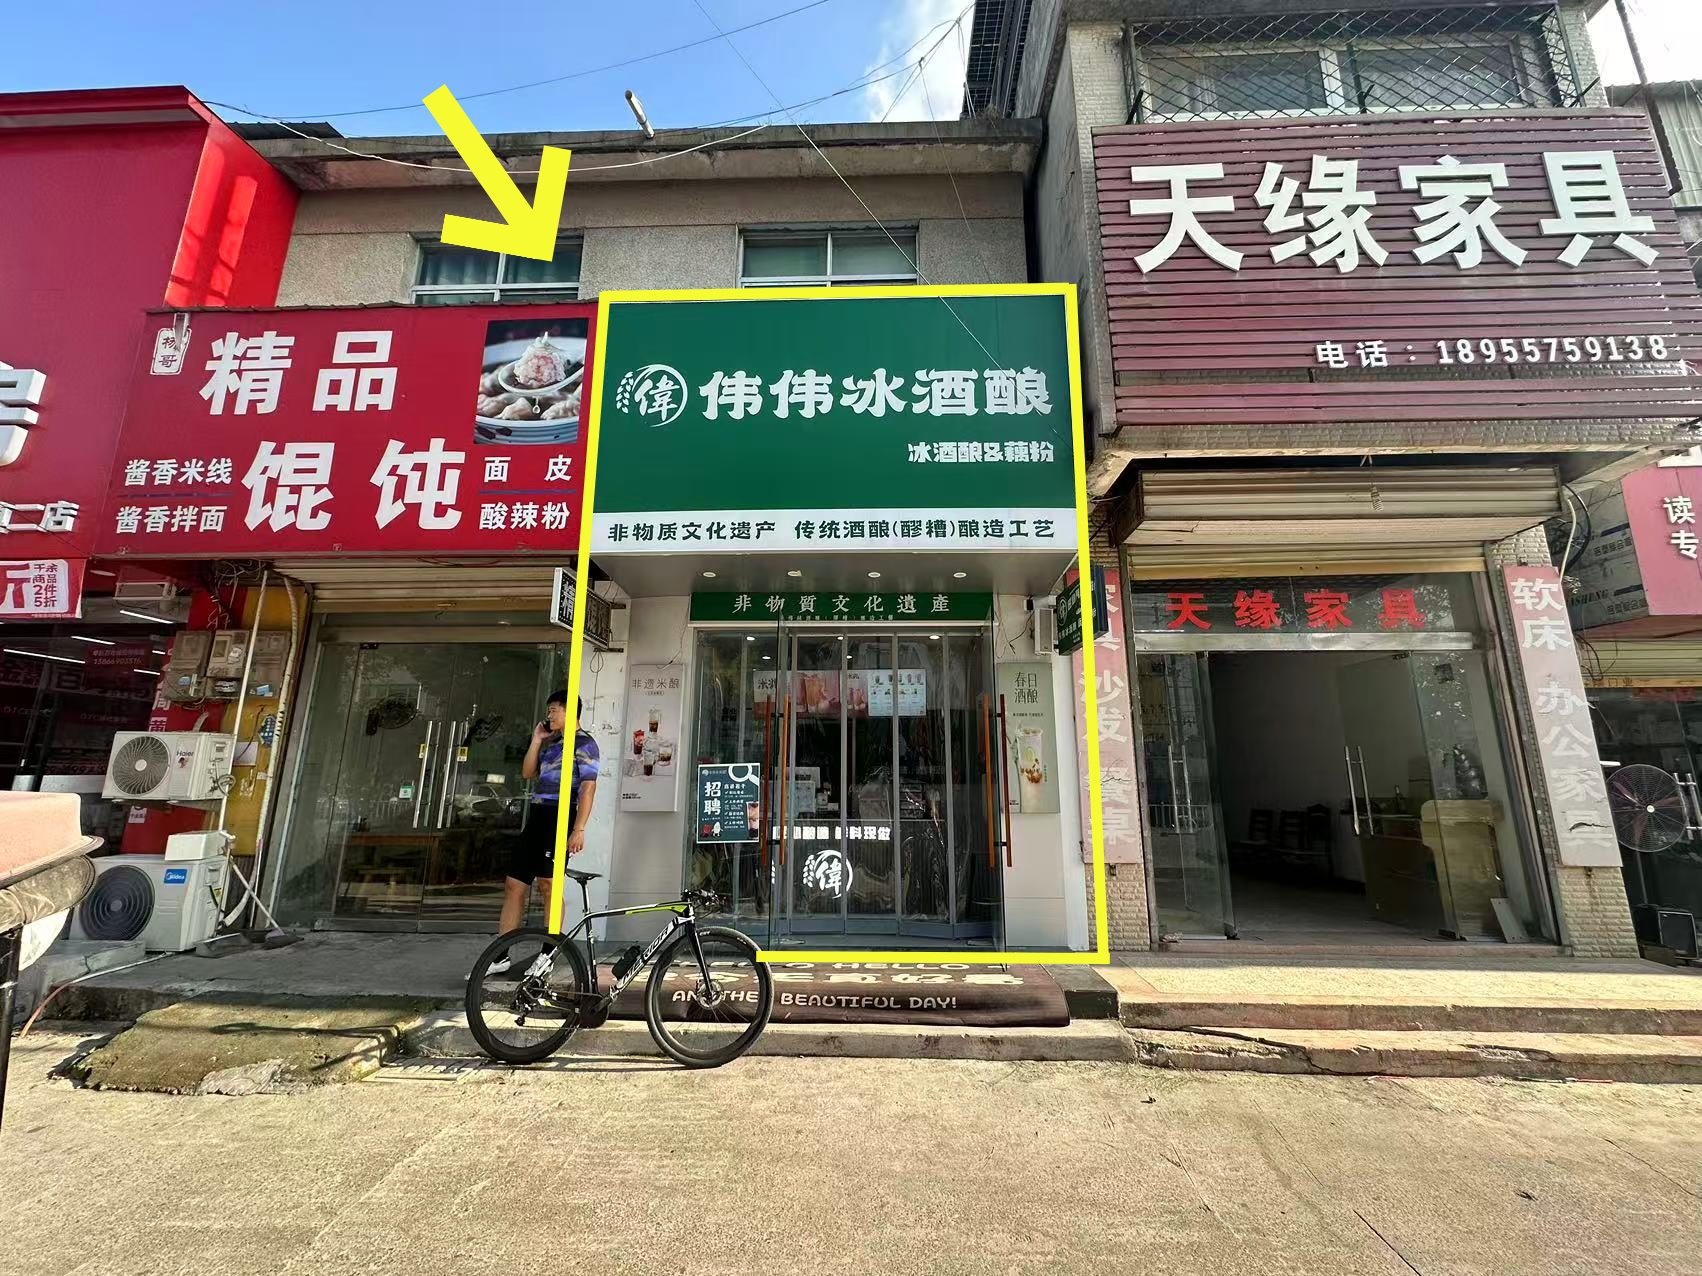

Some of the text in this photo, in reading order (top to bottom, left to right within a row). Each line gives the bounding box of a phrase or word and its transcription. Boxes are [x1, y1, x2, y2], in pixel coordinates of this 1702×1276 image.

[1129, 151, 1660, 274] 天缘家具
[1436, 336, 1668, 364] 18955759138
[199, 330, 398, 415] 精品
[699, 366, 1053, 420] 伟伟冰酒酿
[124, 457, 233, 486] 酱香米线
[483, 454, 573, 482] 面皮
[241, 438, 466, 533] 馄饨
[115, 505, 228, 534] 酱香拌面
[479, 501, 571, 531] 酸辣粉
[607, 521, 776, 542] 非物质文化遗产
[33, 584, 58, 596] 2件
[34, 596, 58, 608] 5折
[1165, 588, 1425, 630] 天缘家具
[1511, 577, 1573, 650] 软床
[703, 781, 722, 816] 招聘
[165, 872, 186, 881] Midea
[780, 992, 902, 1009] BEAUTIFUL
[909, 996, 957, 1009] DAY!
